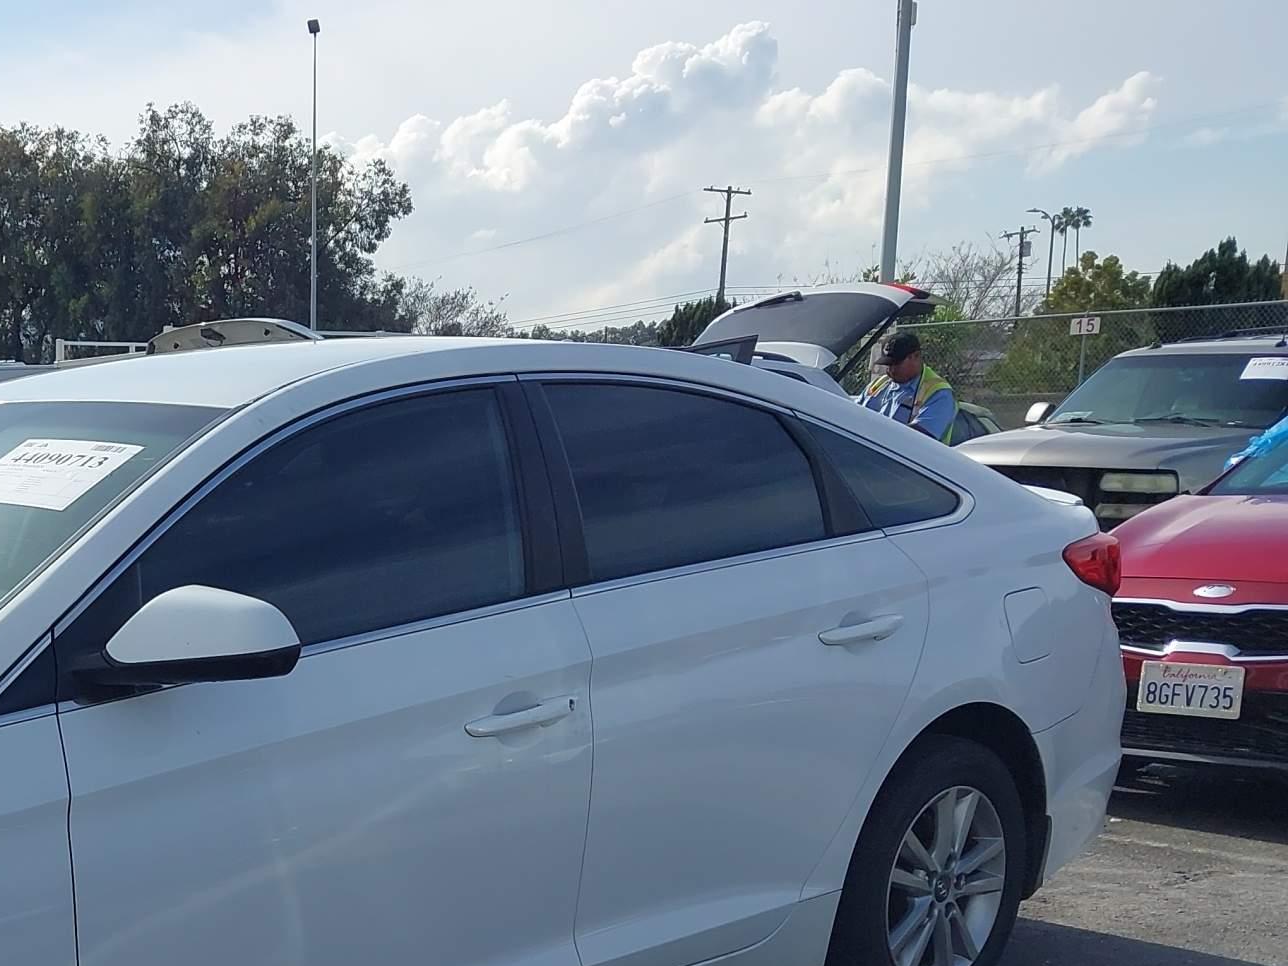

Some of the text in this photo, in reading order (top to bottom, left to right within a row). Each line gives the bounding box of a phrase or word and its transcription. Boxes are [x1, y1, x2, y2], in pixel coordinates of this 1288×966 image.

[1075, 318, 1095, 333] 15
[11, 450, 111, 469] 44090713
[1162, 665, 1220, 682] California
[1145, 681, 1234, 710] 8GFV735
